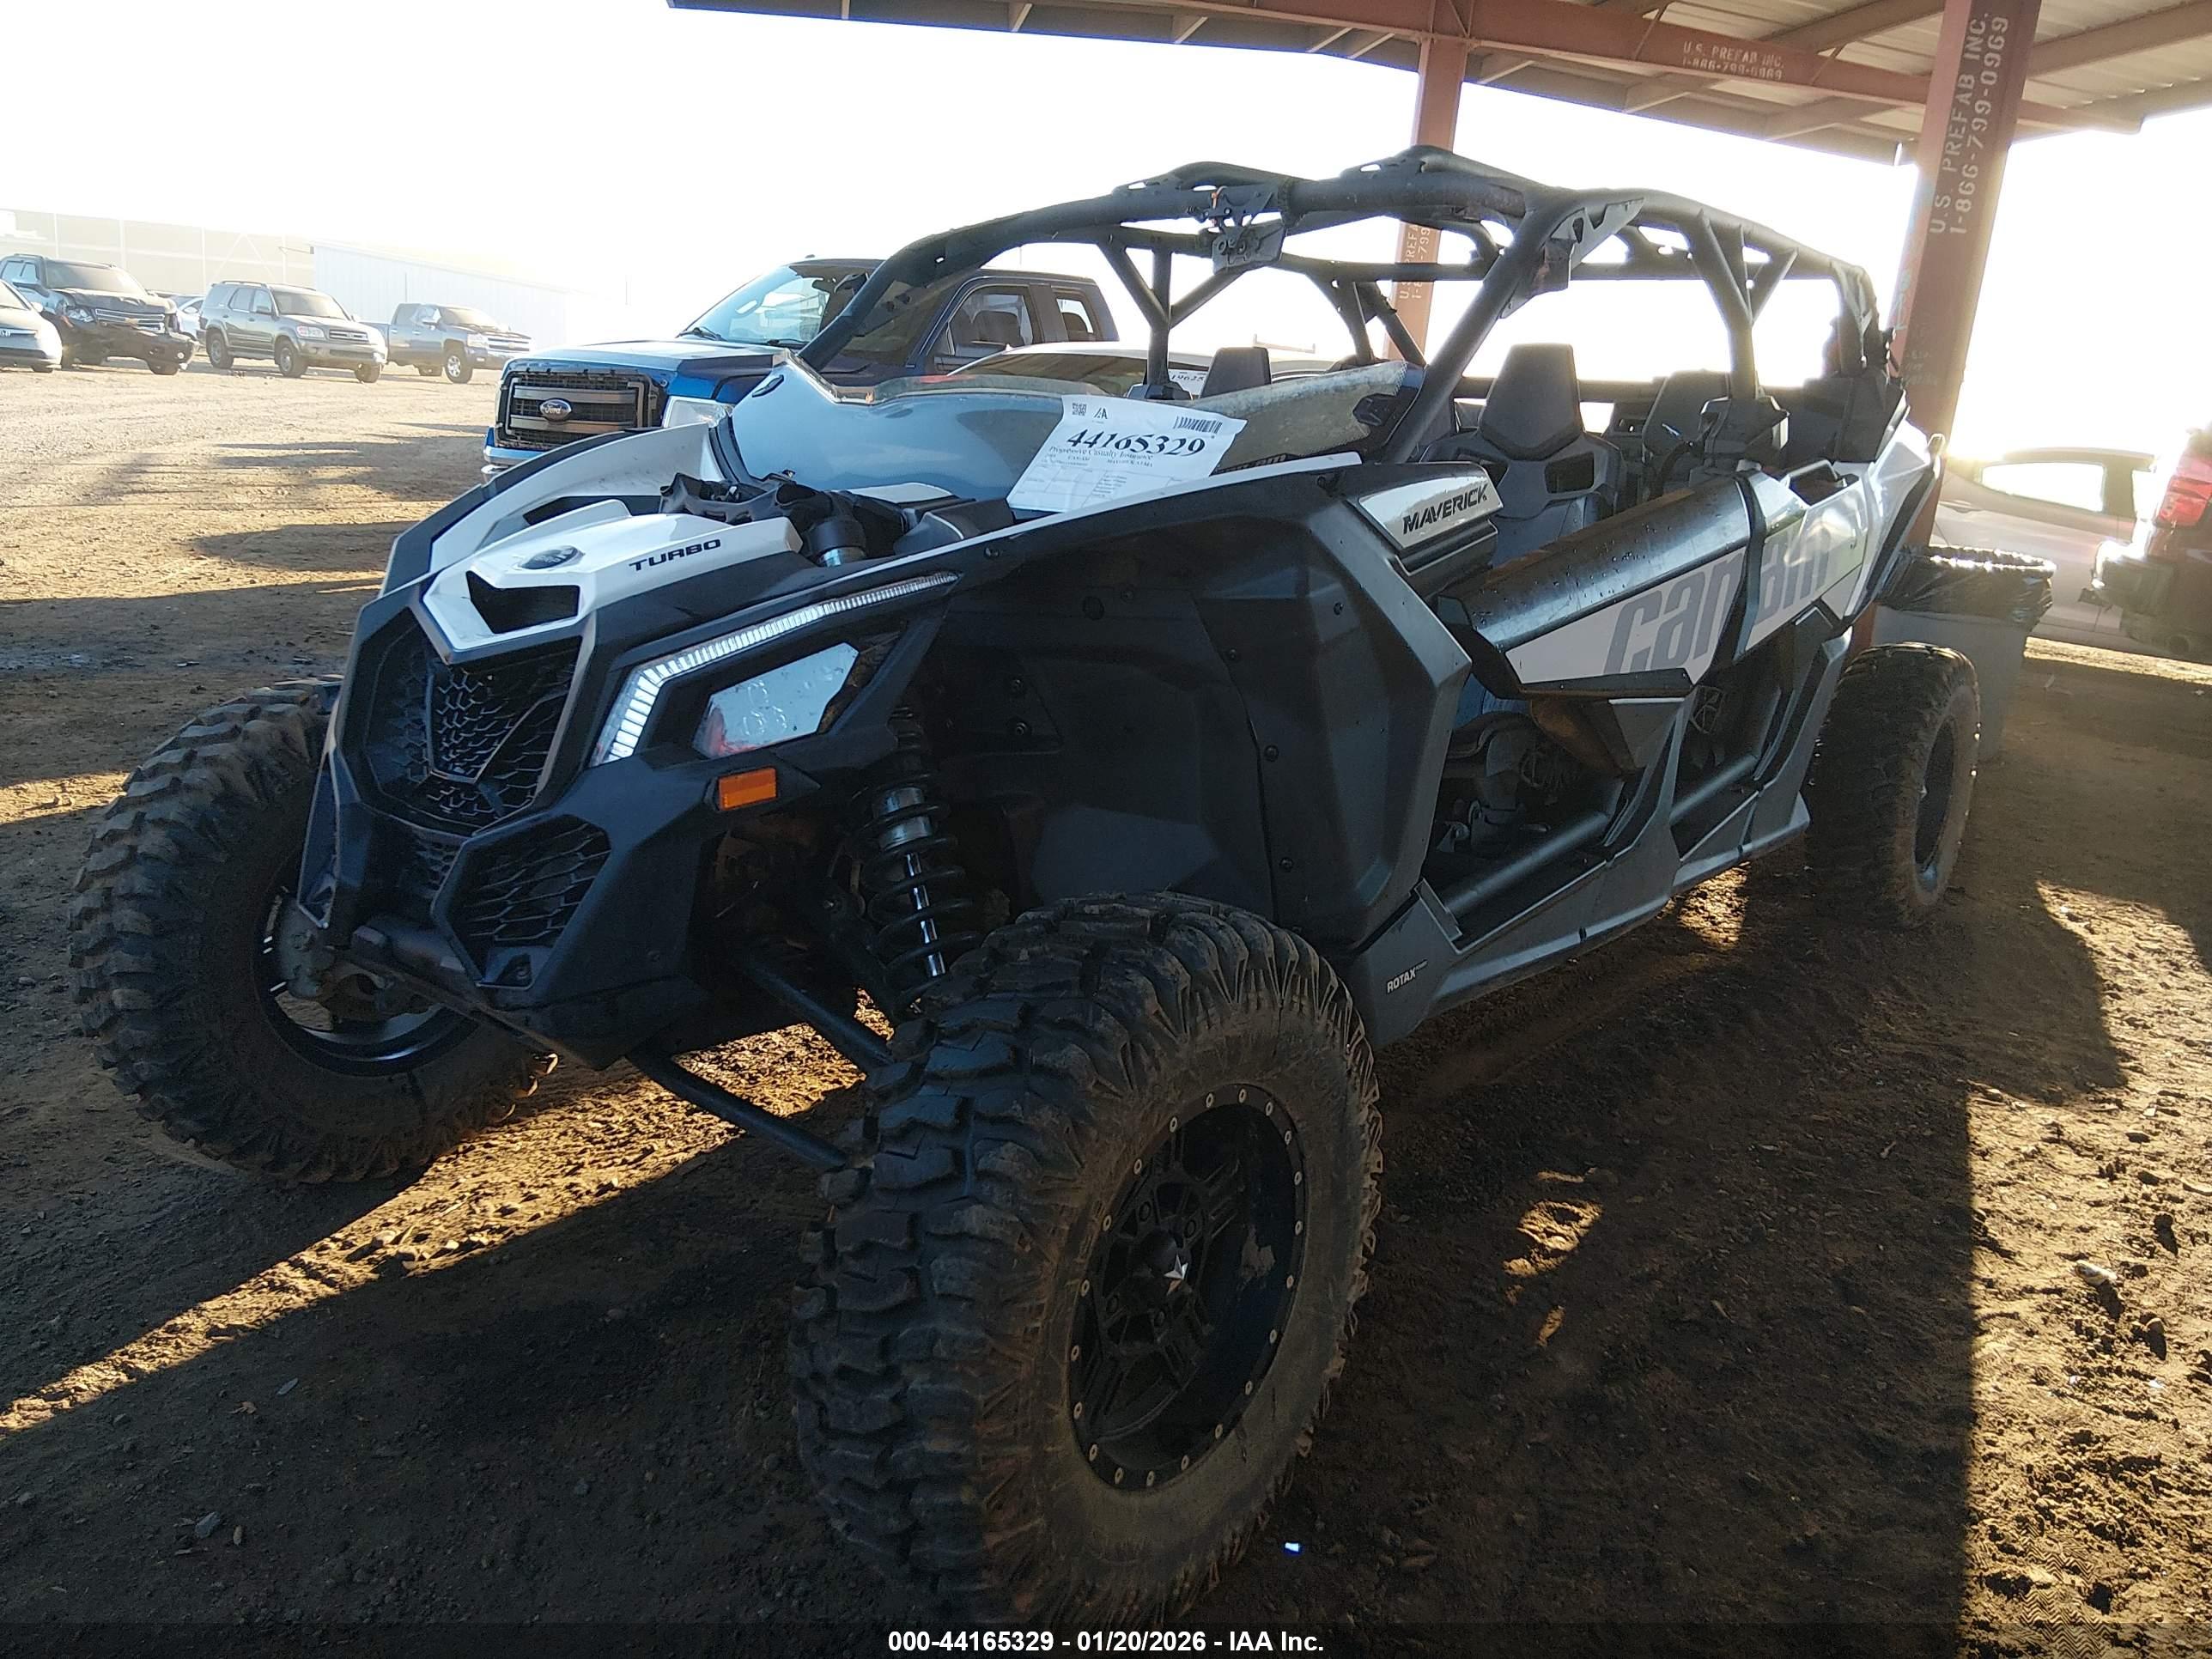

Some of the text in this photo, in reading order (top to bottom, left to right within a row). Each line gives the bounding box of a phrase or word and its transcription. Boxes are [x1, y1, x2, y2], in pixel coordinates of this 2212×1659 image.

[1711, 46, 1759, 64] PREFAB
[1761, 53, 1785, 70] INC.
[1942, 74, 1976, 173] PREFAB
[1971, 12, 1990, 62] INC.
[1948, 15, 2009, 235] 1-866-799-0969
[544, 402, 562, 414] Ford
[1067, 428, 1206, 457] 44165329
[1088, 448, 1117, 459] Casualty
[1402, 483, 1489, 535] MAVERICK
[629, 538, 721, 572] TURBO
[1387, 968, 1416, 994] ROTAX
